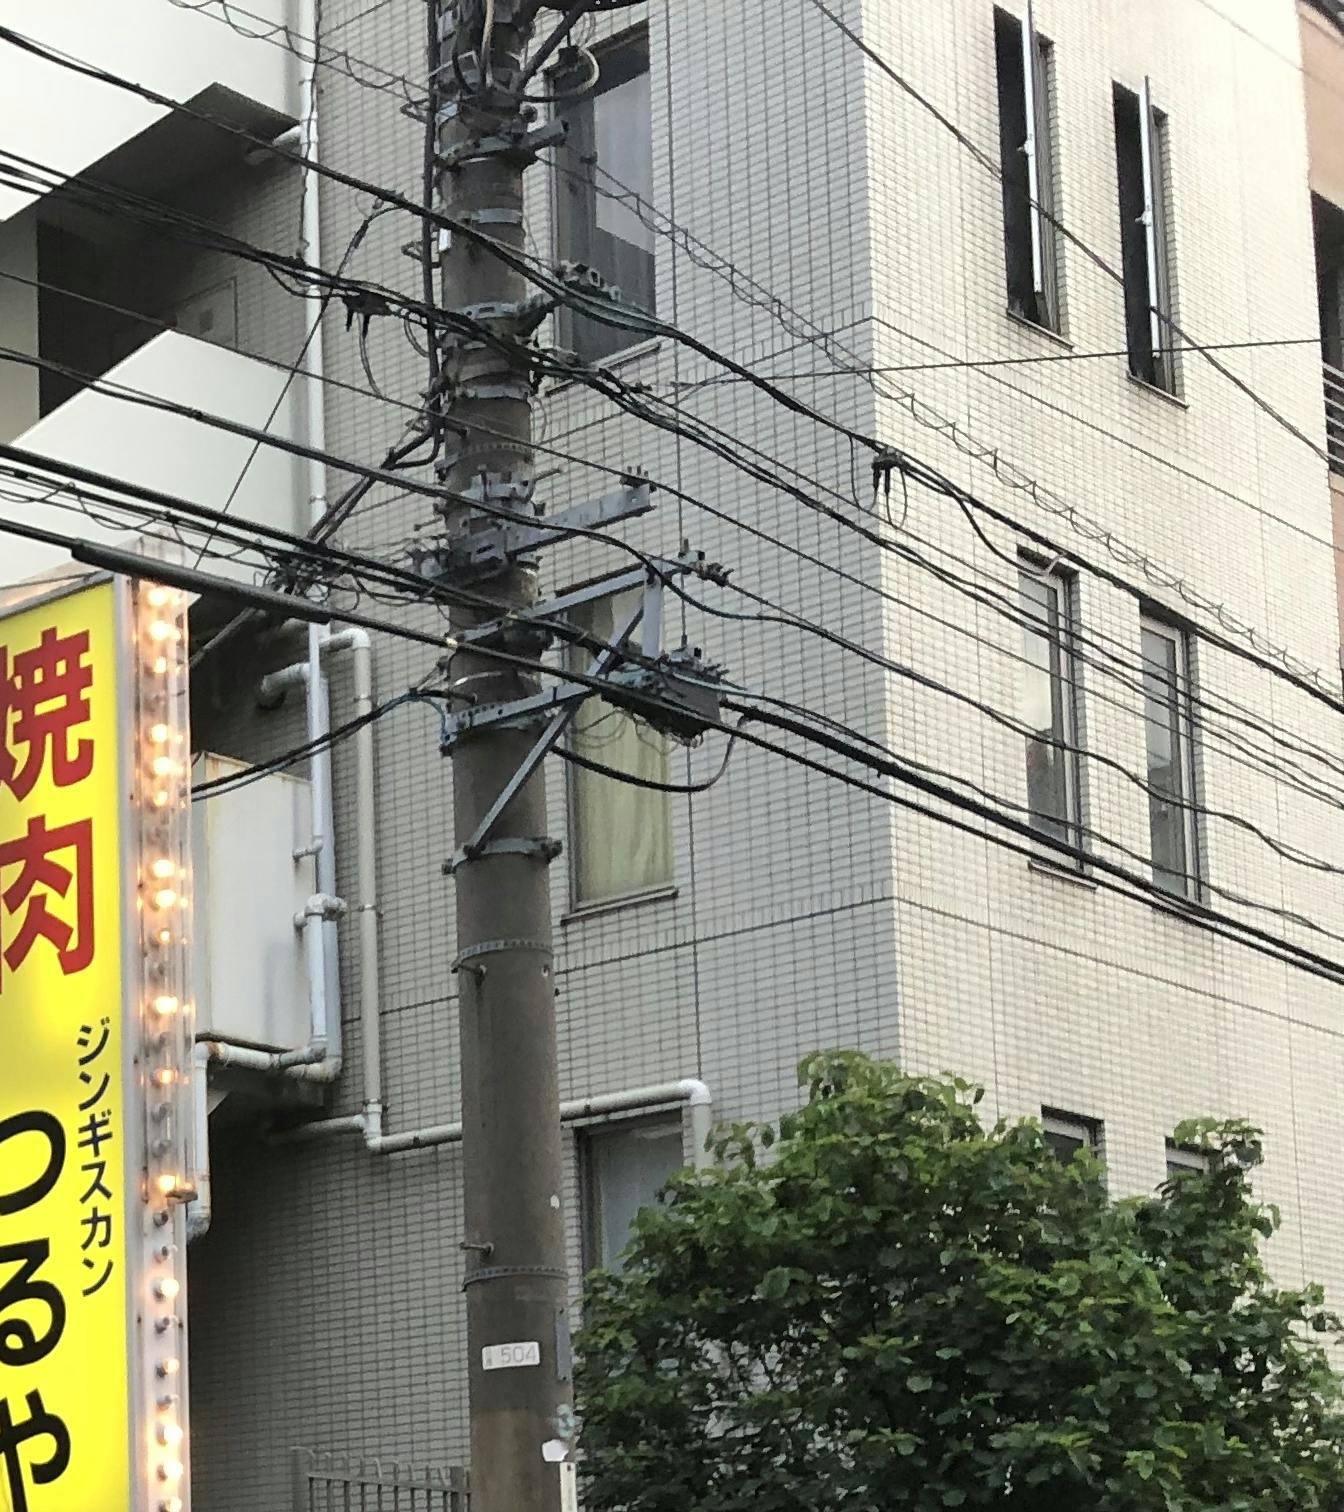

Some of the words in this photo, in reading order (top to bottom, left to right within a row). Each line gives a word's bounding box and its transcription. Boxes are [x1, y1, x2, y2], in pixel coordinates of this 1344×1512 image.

[76, 1016, 113, 1297] ジンギスカン
[500, 1344, 537, 1364] 504
